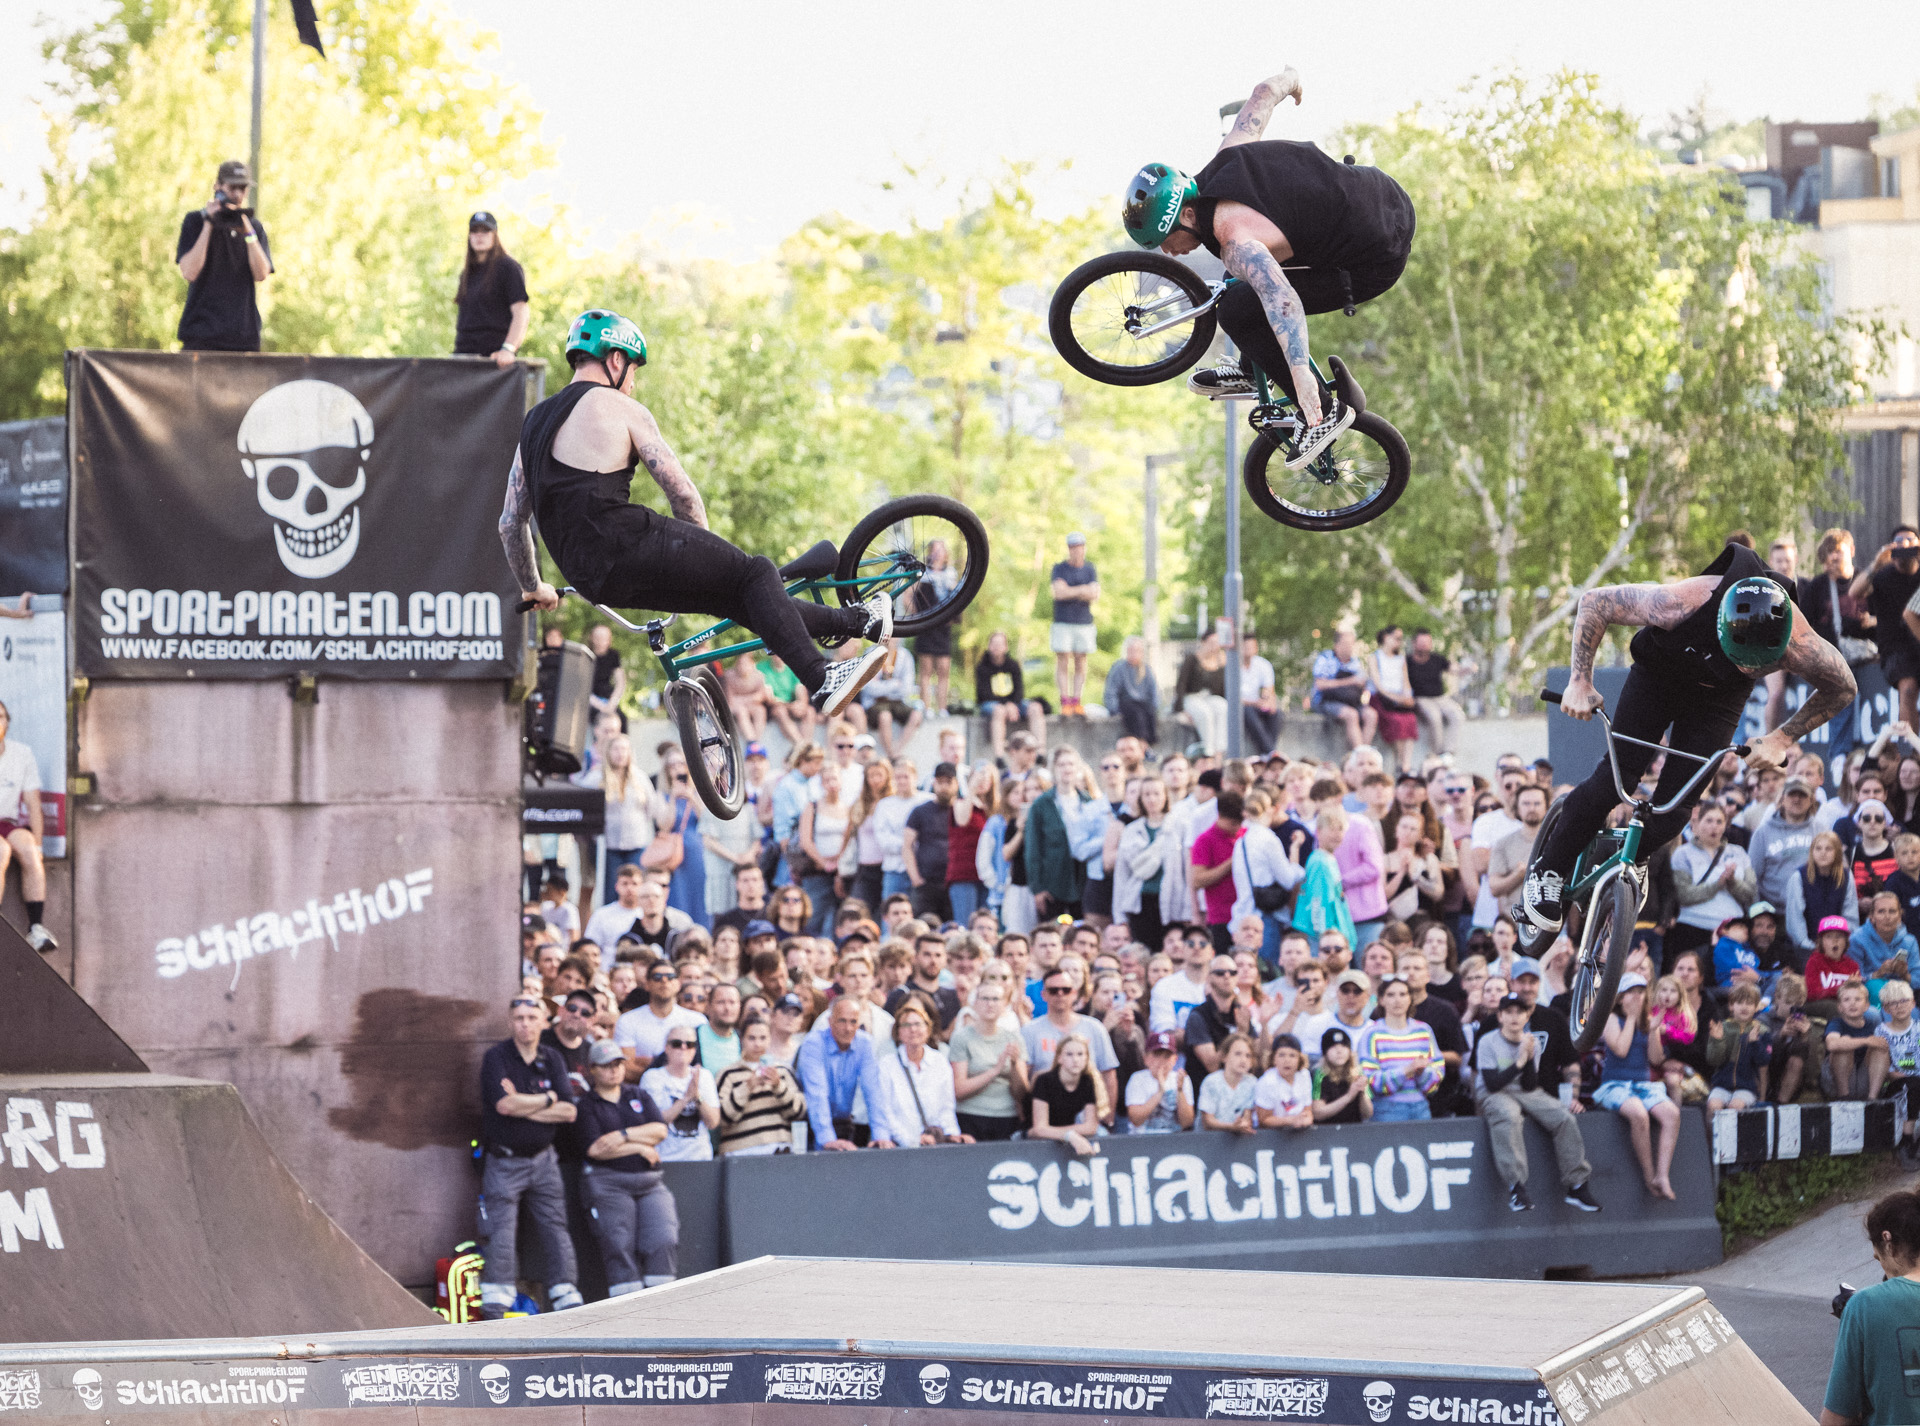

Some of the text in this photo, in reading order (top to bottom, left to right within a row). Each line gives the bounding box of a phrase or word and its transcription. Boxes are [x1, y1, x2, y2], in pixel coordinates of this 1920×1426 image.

[1157, 184, 1183, 233] CANNA
[601, 328, 642, 351] CANNA
[683, 629, 716, 650] CANNA
[100, 638, 504, 661] WWW.FACEBOOK.COM/SCHLACHTHOF2001
[0, 1097, 107, 1174] RG
[344, 1367, 455, 1385] KEIN BOCK
[767, 1367, 878, 1381] KEIN BOCK
[392, 1383, 457, 1398] NAZIS
[814, 1382, 880, 1397] NAZIS
[1208, 1384, 1321, 1398] KEIN BOCK
[1256, 1398, 1322, 1414] NAZIS
